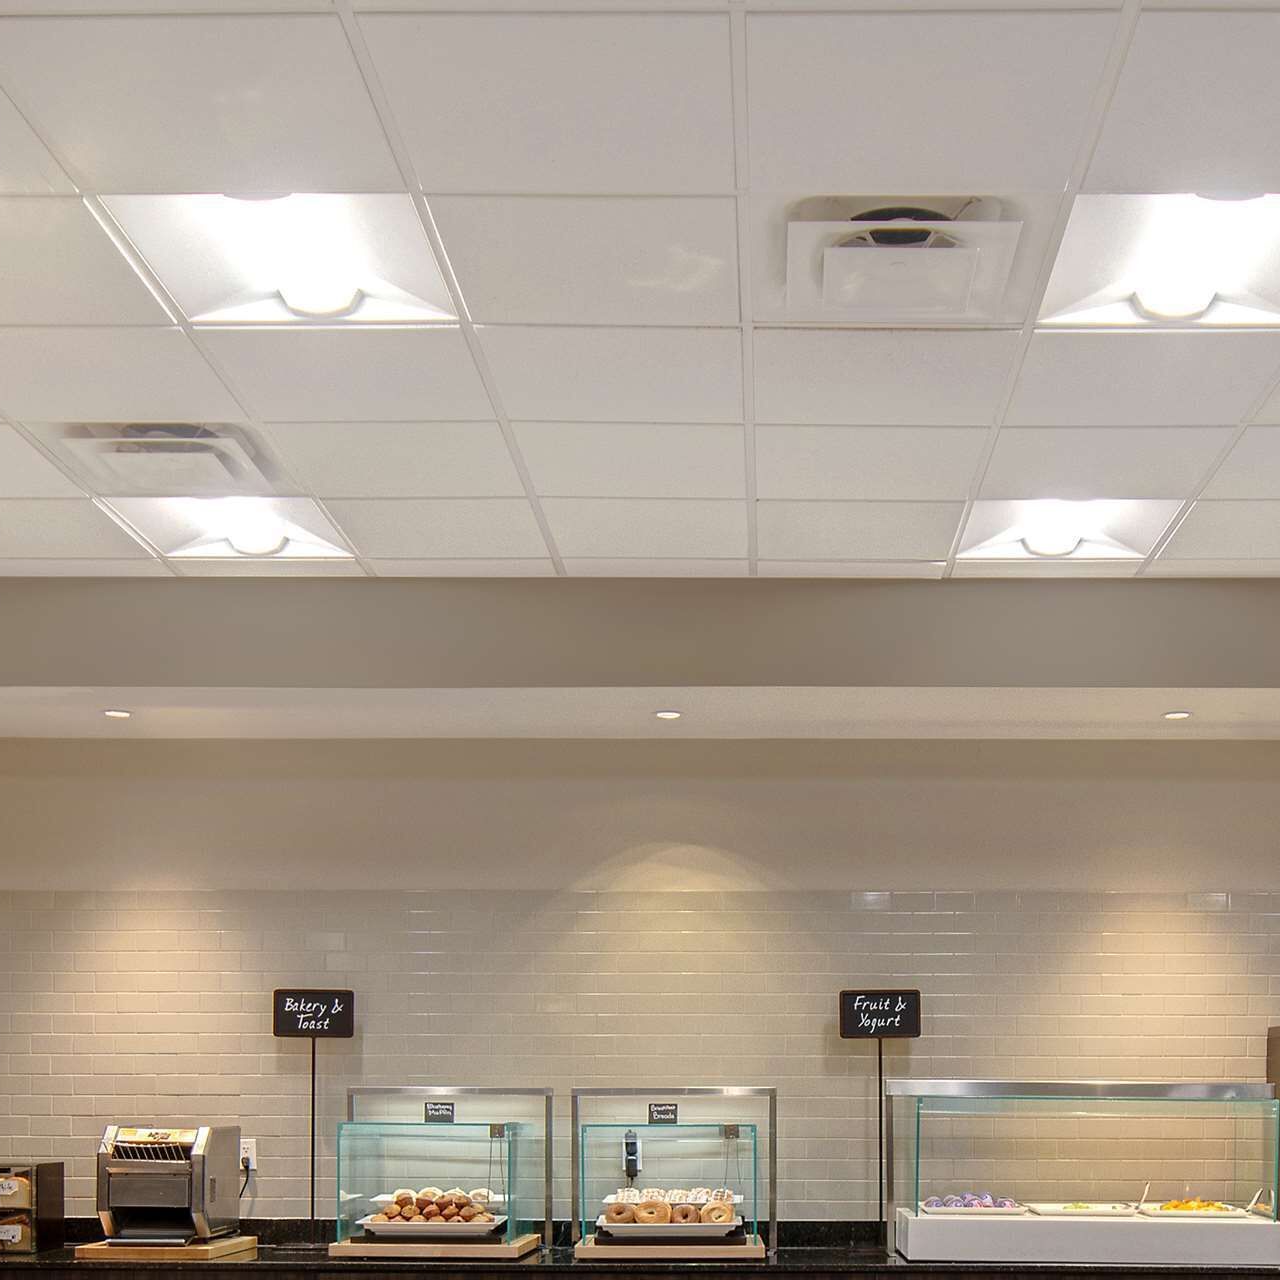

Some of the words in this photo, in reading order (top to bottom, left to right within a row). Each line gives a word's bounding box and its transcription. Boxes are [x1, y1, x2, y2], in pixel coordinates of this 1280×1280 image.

[284, 997, 327, 1018] Bakery
[331, 997, 344, 1014] &
[854, 995, 890, 1011] Fruit
[894, 995, 907, 1012] &
[296, 1013, 330, 1030] Toast
[858, 1012, 901, 1034] Yogurt
